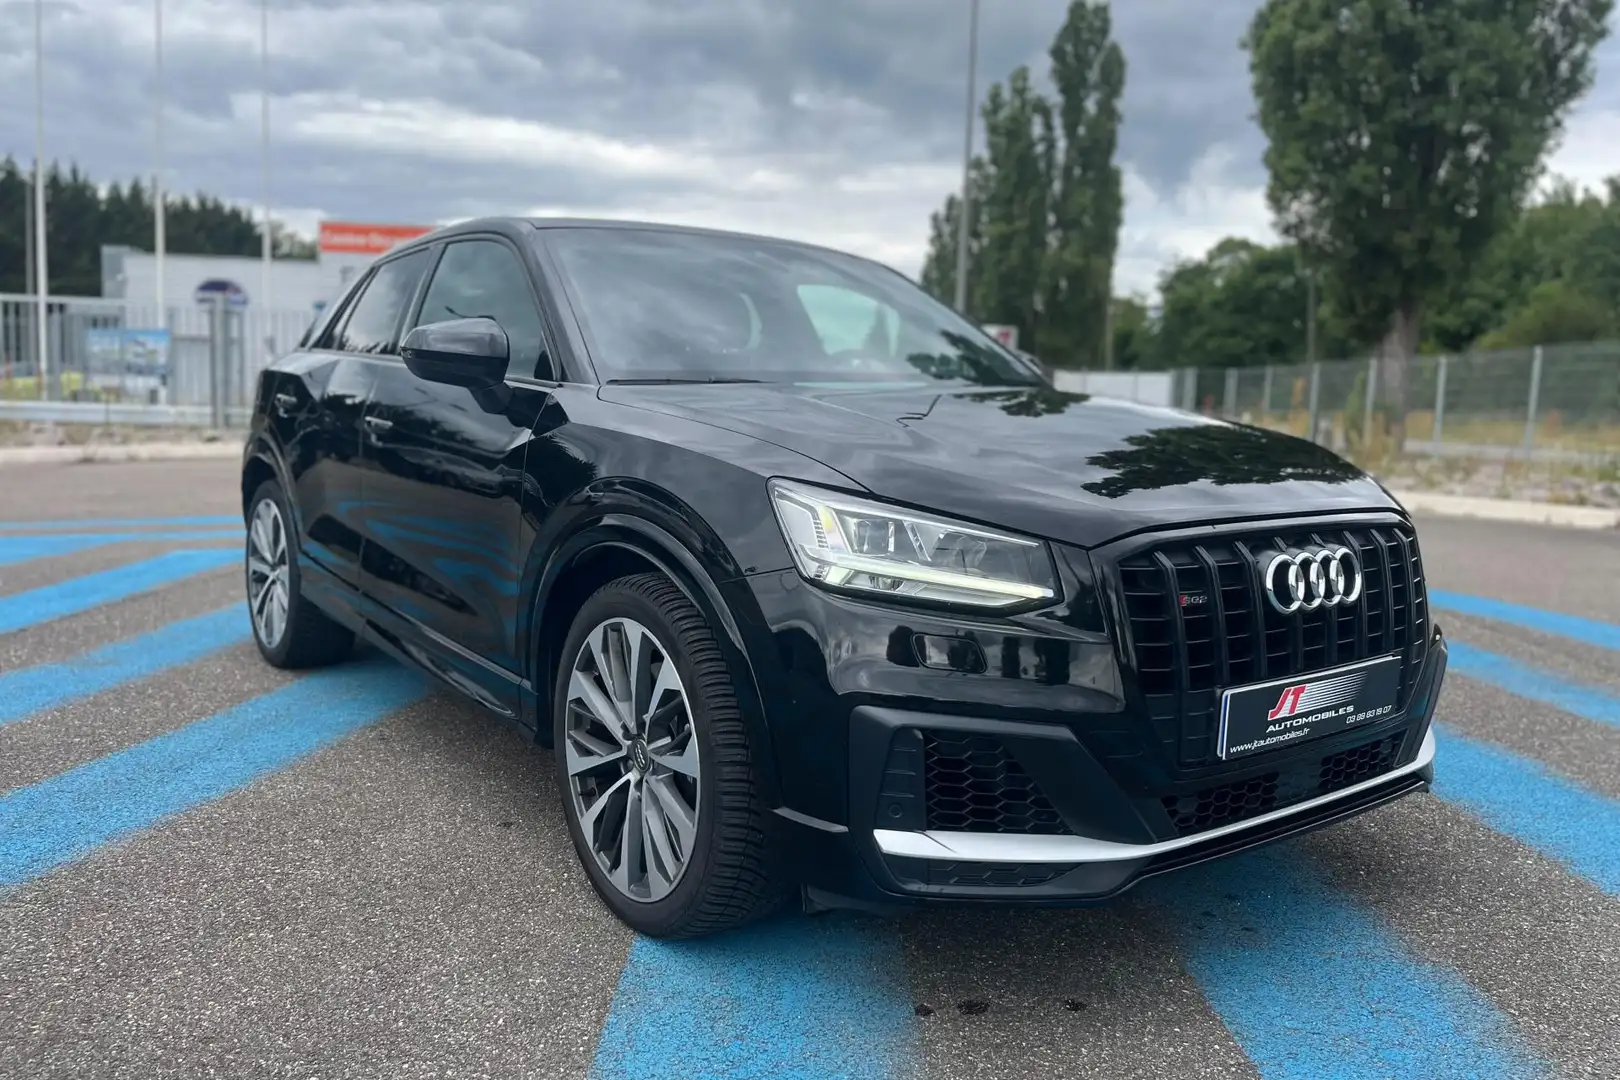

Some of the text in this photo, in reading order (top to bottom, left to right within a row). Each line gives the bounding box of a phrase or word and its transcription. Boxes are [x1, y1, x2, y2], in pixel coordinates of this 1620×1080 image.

[1268, 684, 1307, 721] JT
[1346, 715, 1356, 724] 03
[1383, 705, 1392, 714] 07
[1266, 705, 1355, 733] AUTOMOBILES
[1229, 727, 1311, 754] www.jtautomobiles.fr
